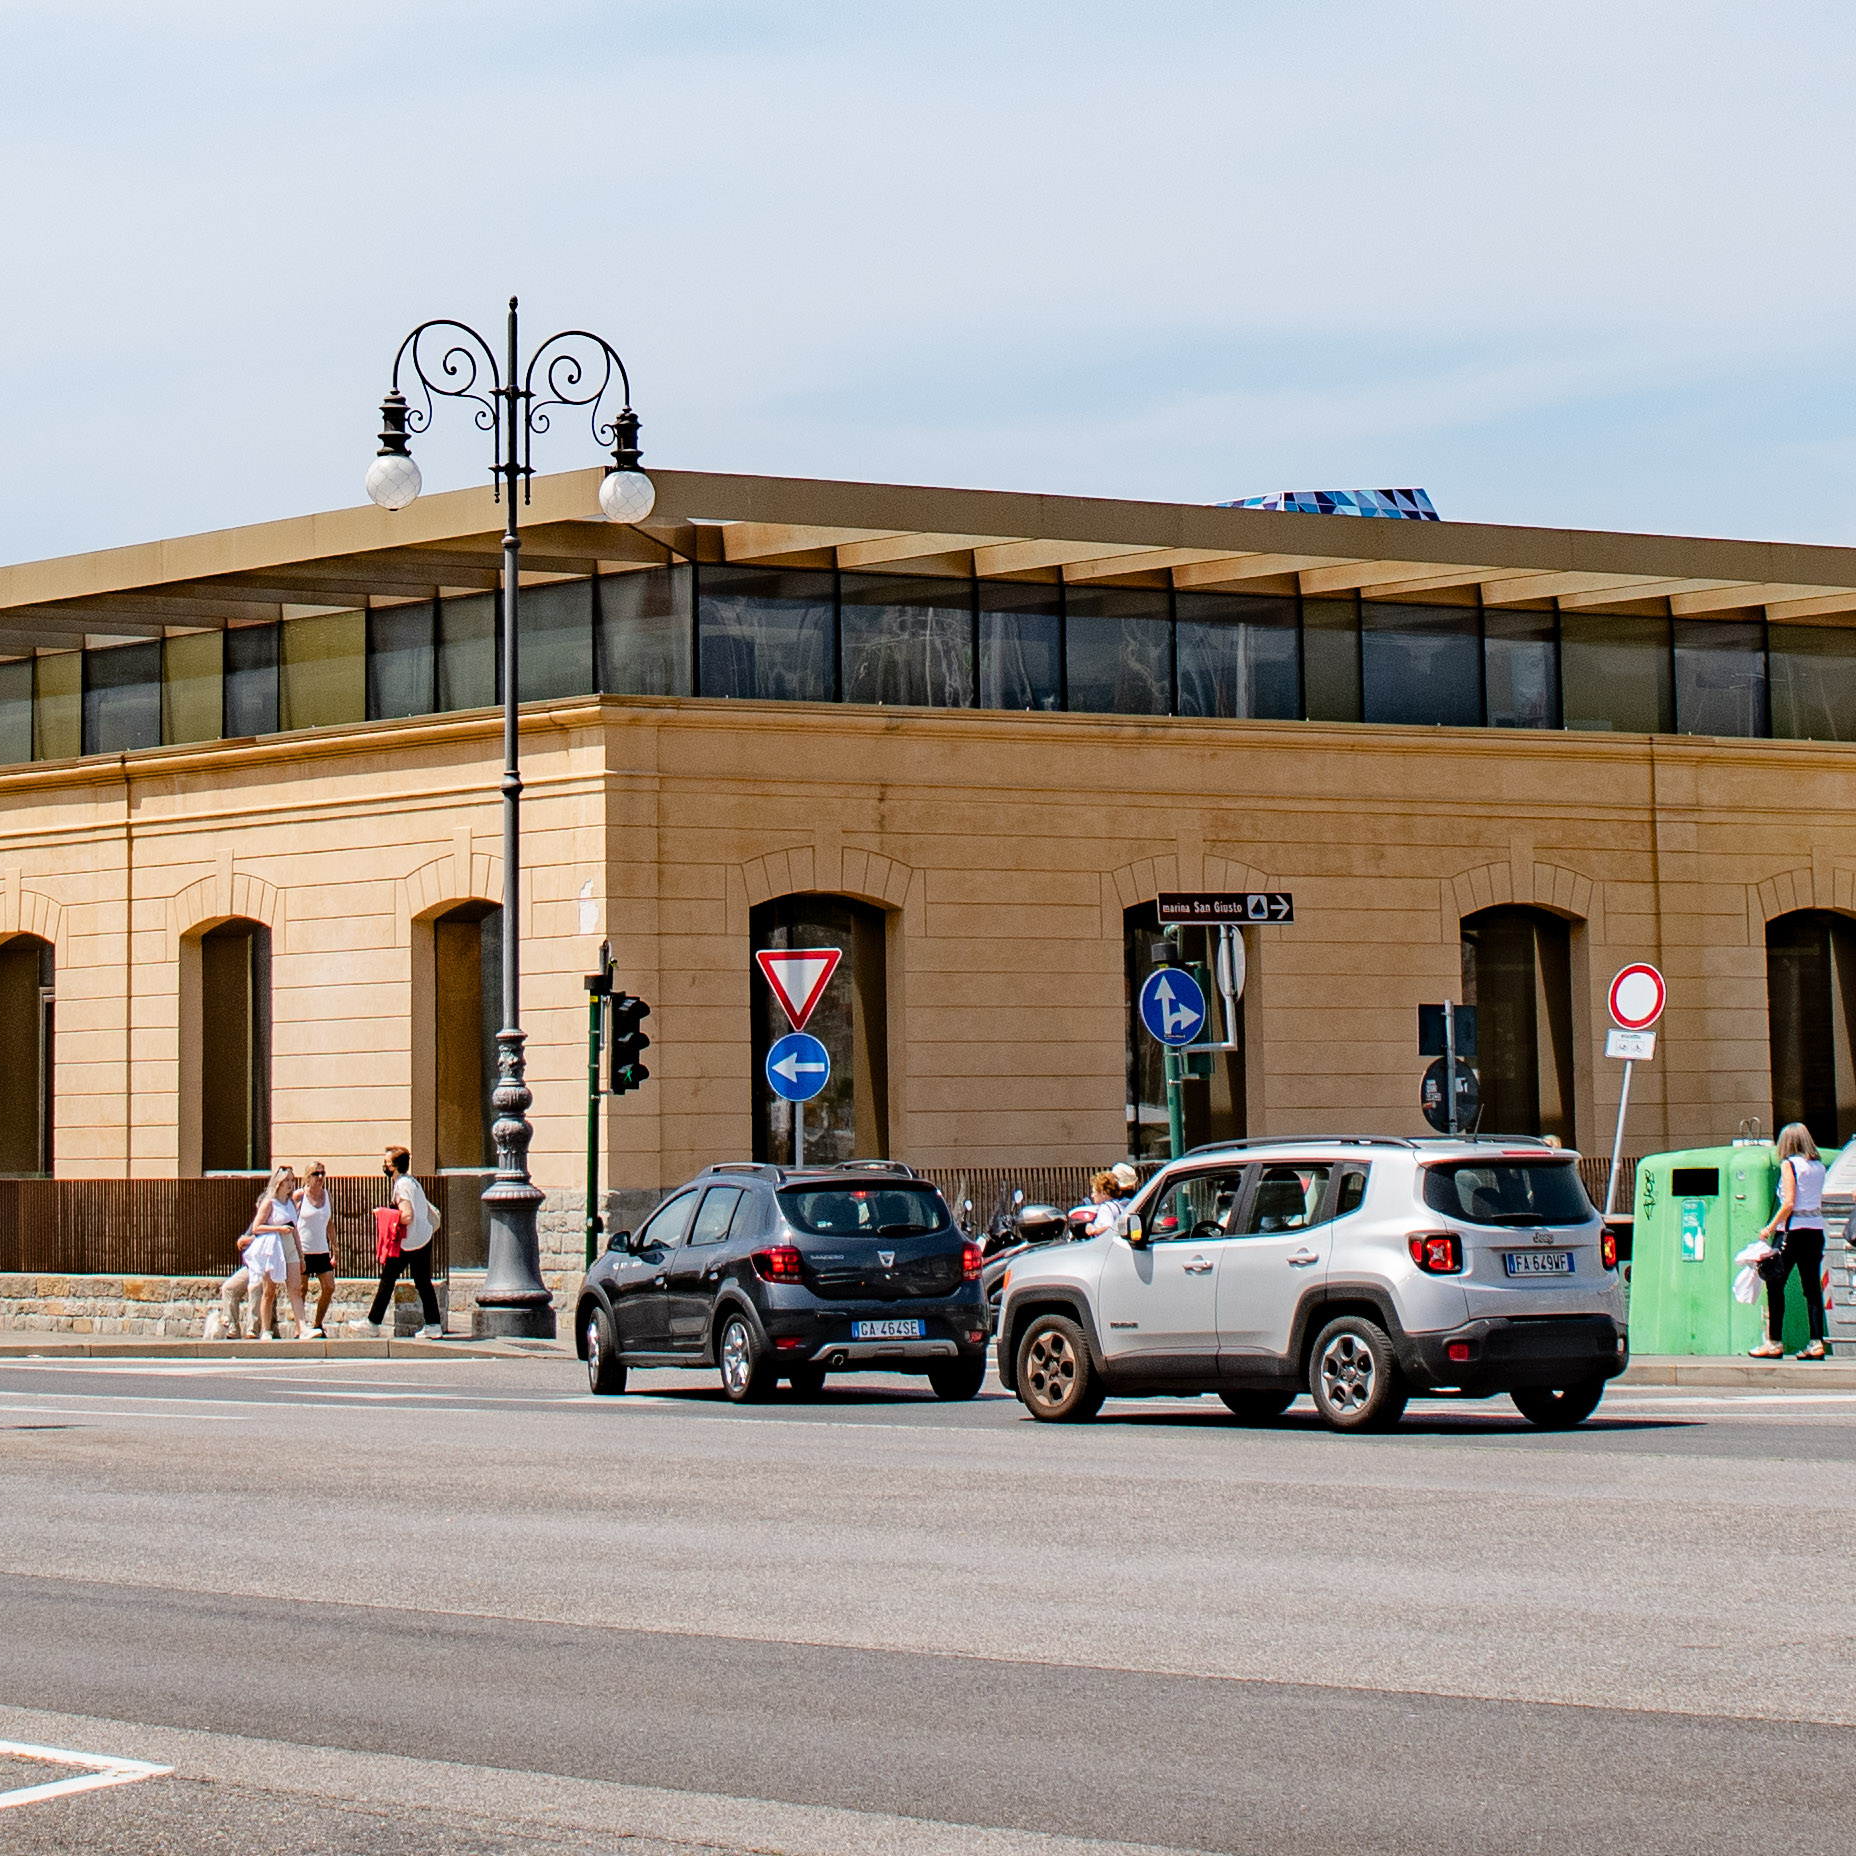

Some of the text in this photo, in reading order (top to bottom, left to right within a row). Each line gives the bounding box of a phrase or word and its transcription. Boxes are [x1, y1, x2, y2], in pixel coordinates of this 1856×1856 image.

[1162, 901, 1243, 913] marina San Giusto
[1532, 1231, 1554, 1245] Jeep
[1515, 1254, 1566, 1271] FA 649WF
[881, 1320, 918, 1335] 464SE
